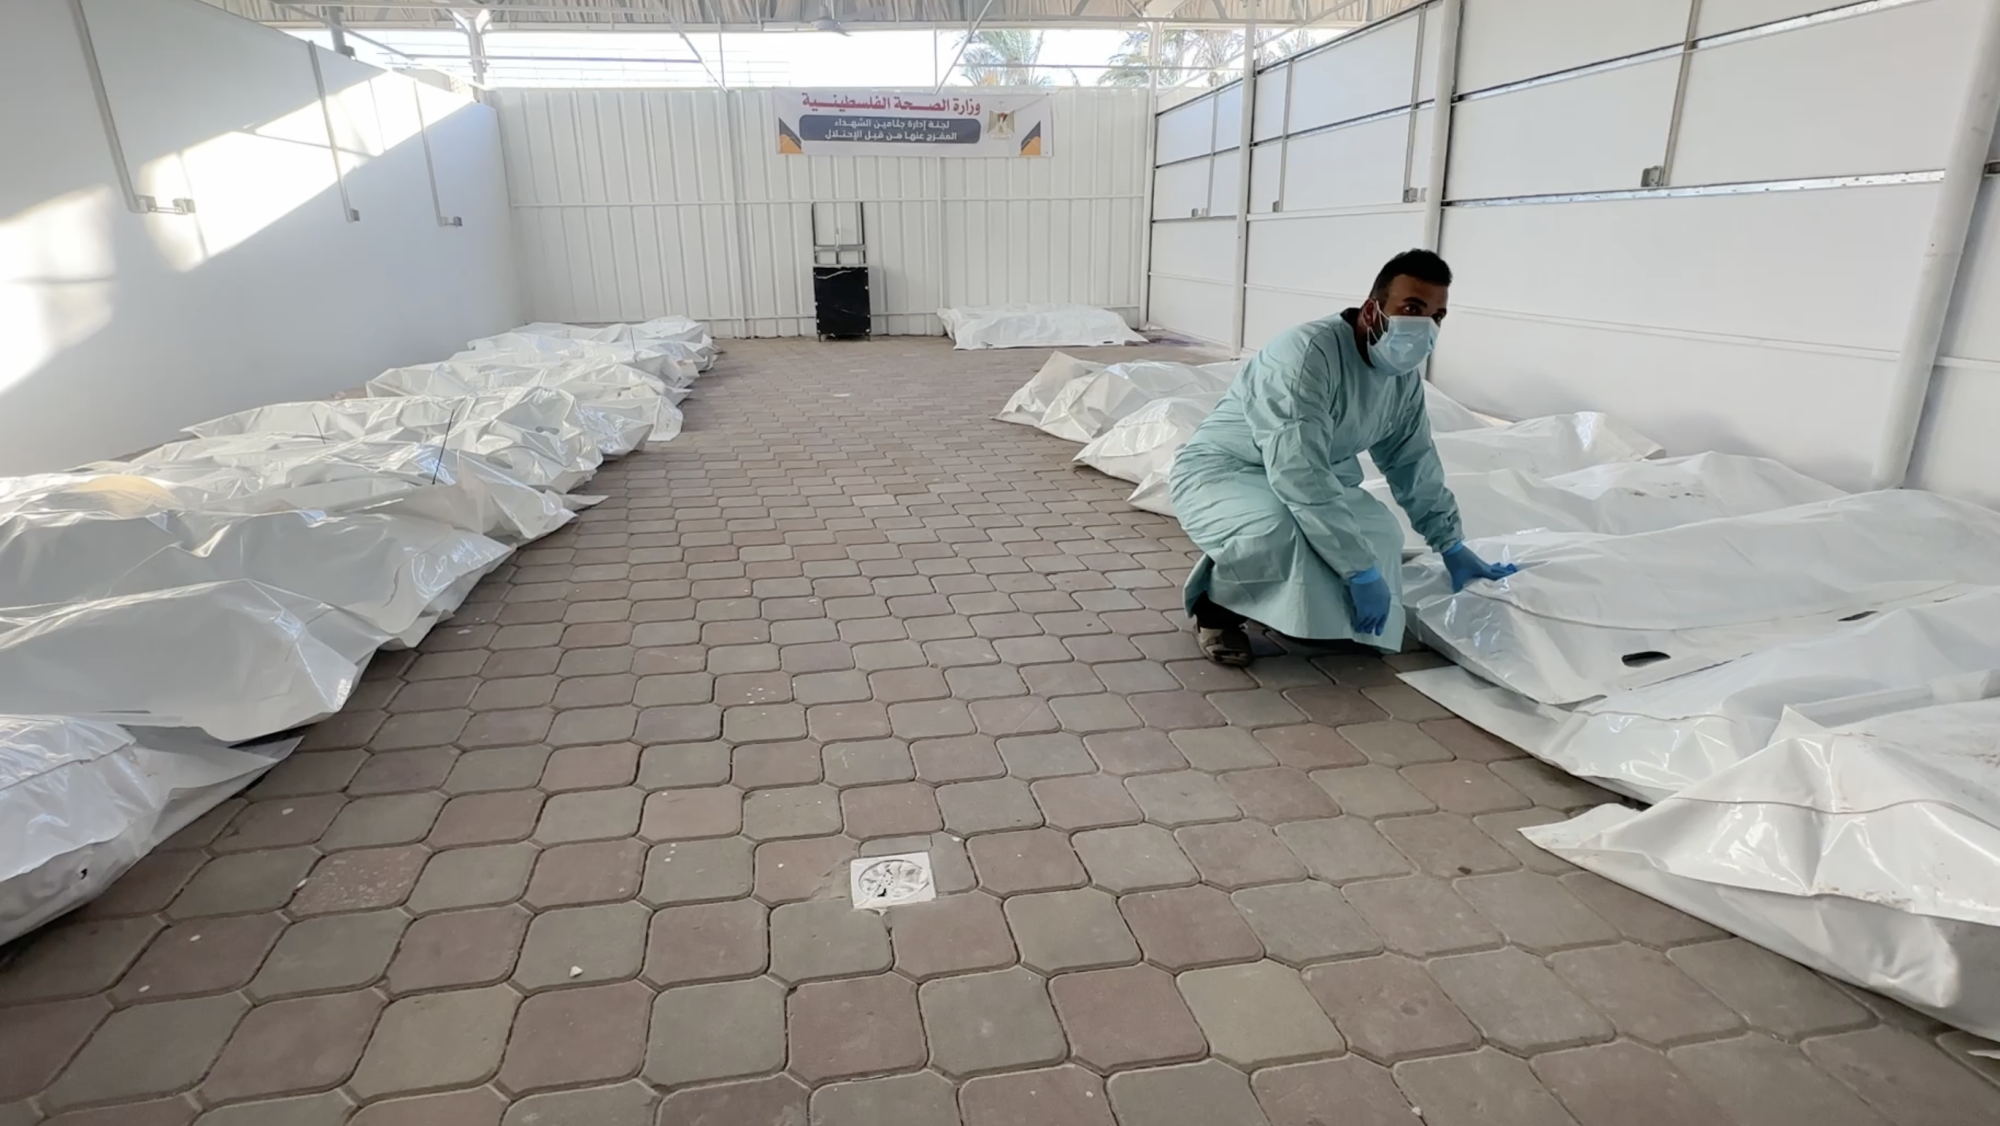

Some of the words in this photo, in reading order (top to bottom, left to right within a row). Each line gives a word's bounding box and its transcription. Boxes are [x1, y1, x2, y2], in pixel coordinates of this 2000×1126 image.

[801, 92, 891, 112] الفلسطينية
[893, 96, 950, 111] الصحة
[953, 97, 981, 115] وزارة
[834, 117, 872, 129] الشهداء
[873, 117, 906, 130] جثامين
[907, 119, 926, 131] إدارة
[927, 120, 950, 131] لجنة
[864, 130, 885, 141] قبل
[885, 132, 903, 142] من
[904, 131, 925, 142] عنها
[926, 131, 958, 142] المفرج
